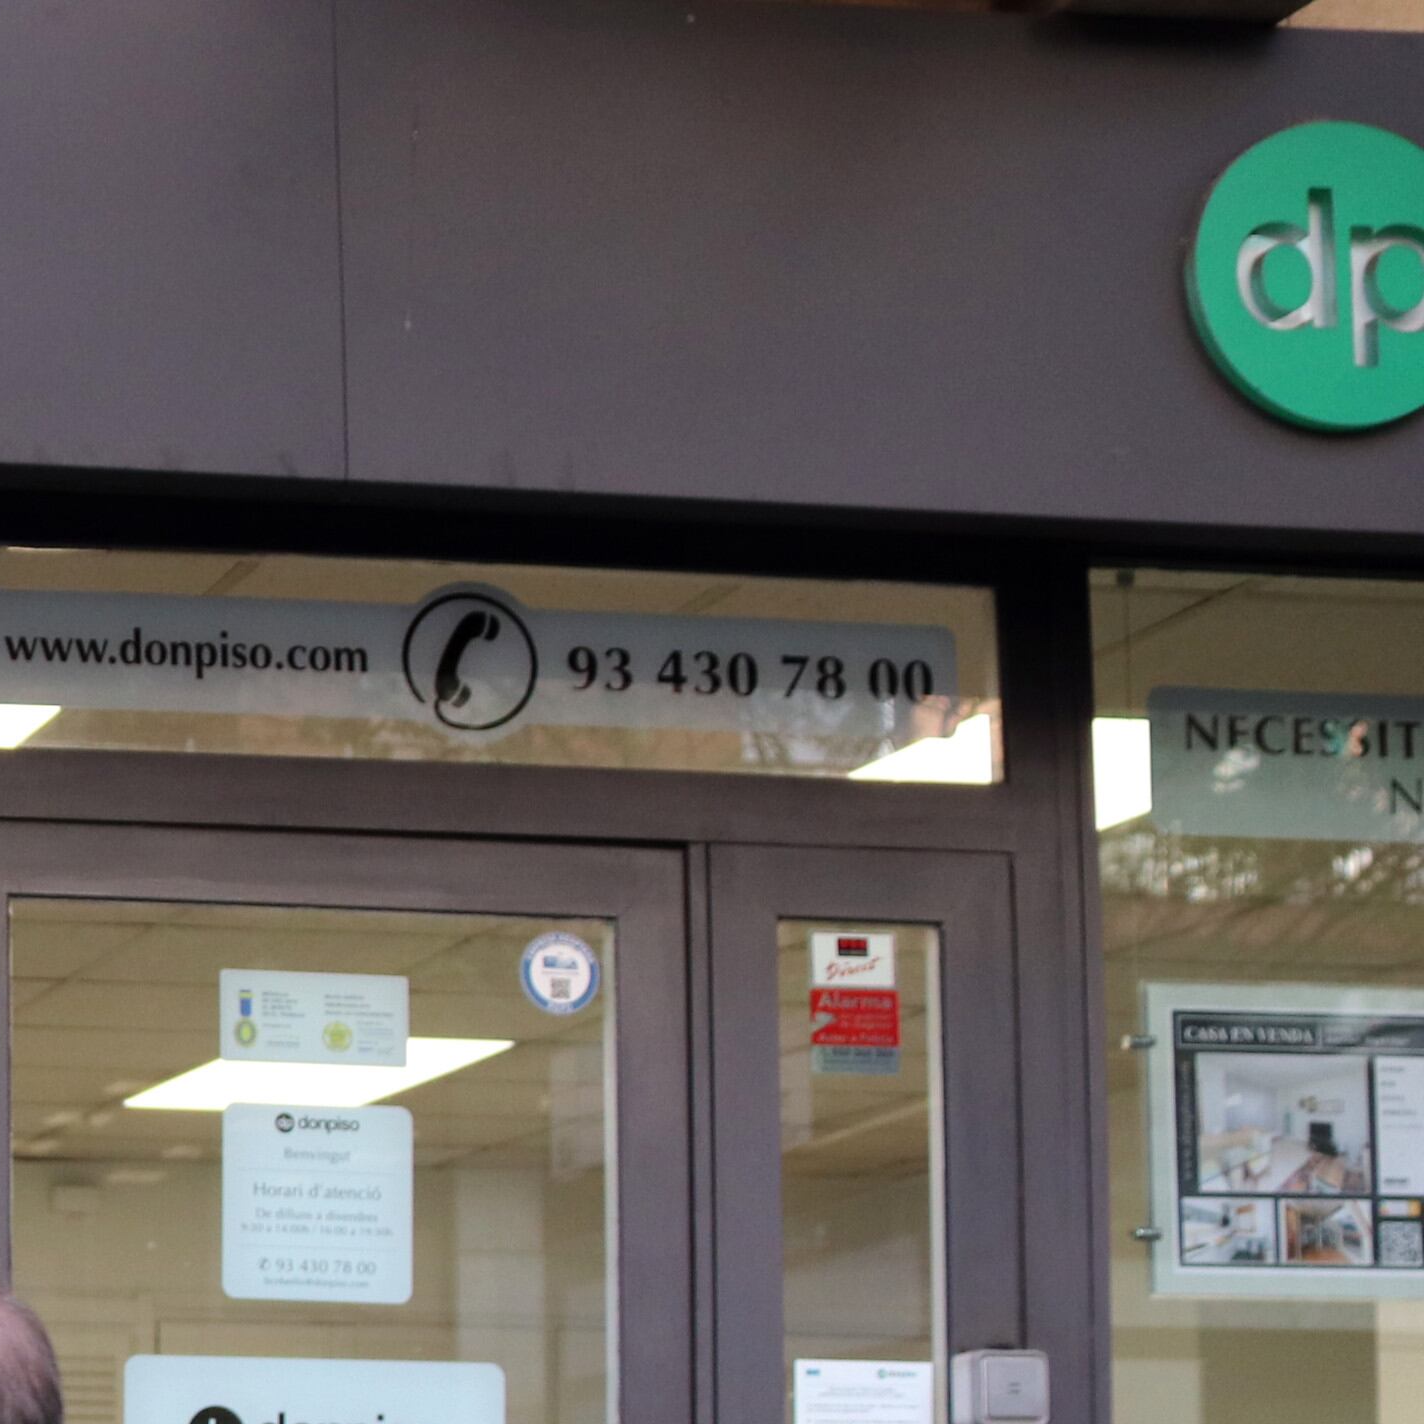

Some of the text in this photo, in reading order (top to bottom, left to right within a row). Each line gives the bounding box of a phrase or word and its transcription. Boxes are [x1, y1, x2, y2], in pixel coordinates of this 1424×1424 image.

[1236, 186, 1424, 367] dp
[5, 629, 368, 677] www.donpiso.com
[567, 645, 933, 704] 93 430 78 00
[298, 1114, 360, 1134] donpiso
[253, 1181, 305, 1197] Horari
